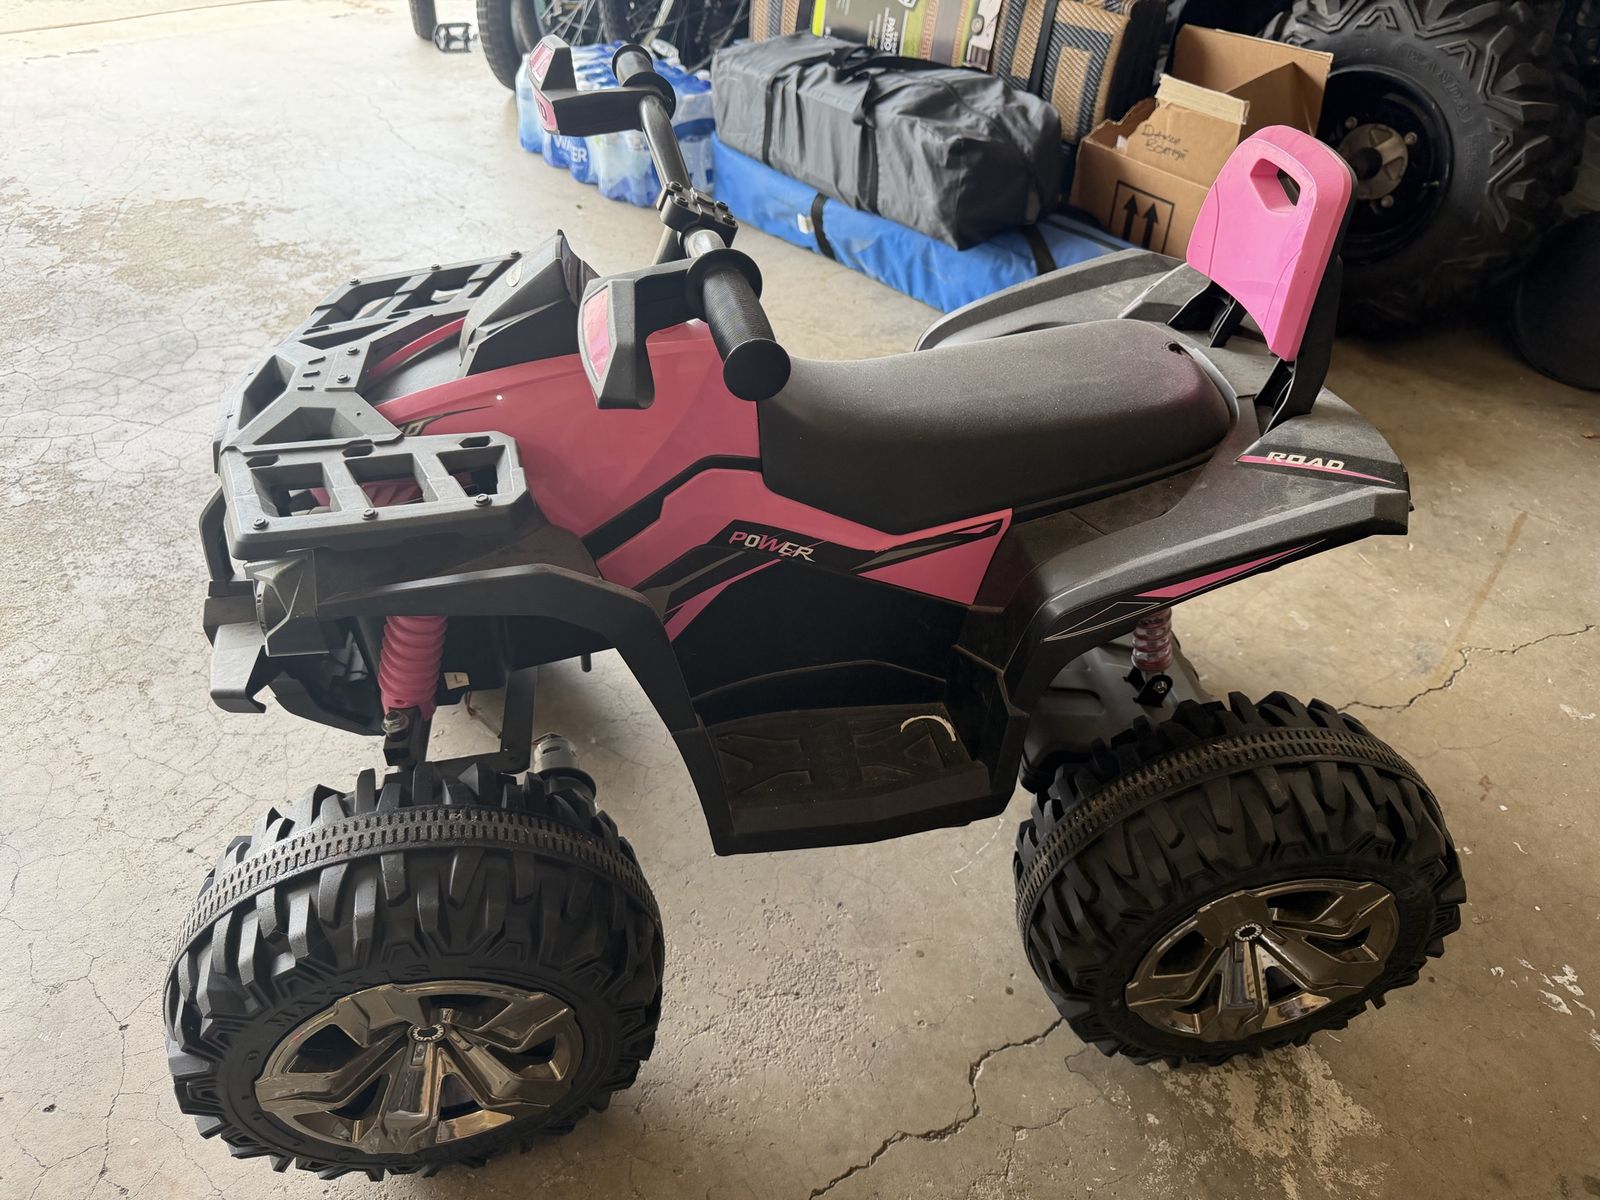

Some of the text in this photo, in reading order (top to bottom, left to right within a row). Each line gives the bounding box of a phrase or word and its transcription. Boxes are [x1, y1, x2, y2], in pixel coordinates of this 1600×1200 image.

[883, 16, 896, 51] PATIO
[551, 134, 587, 162] WER
[1265, 451, 1345, 470] ROAD
[728, 531, 816, 562] POWER
